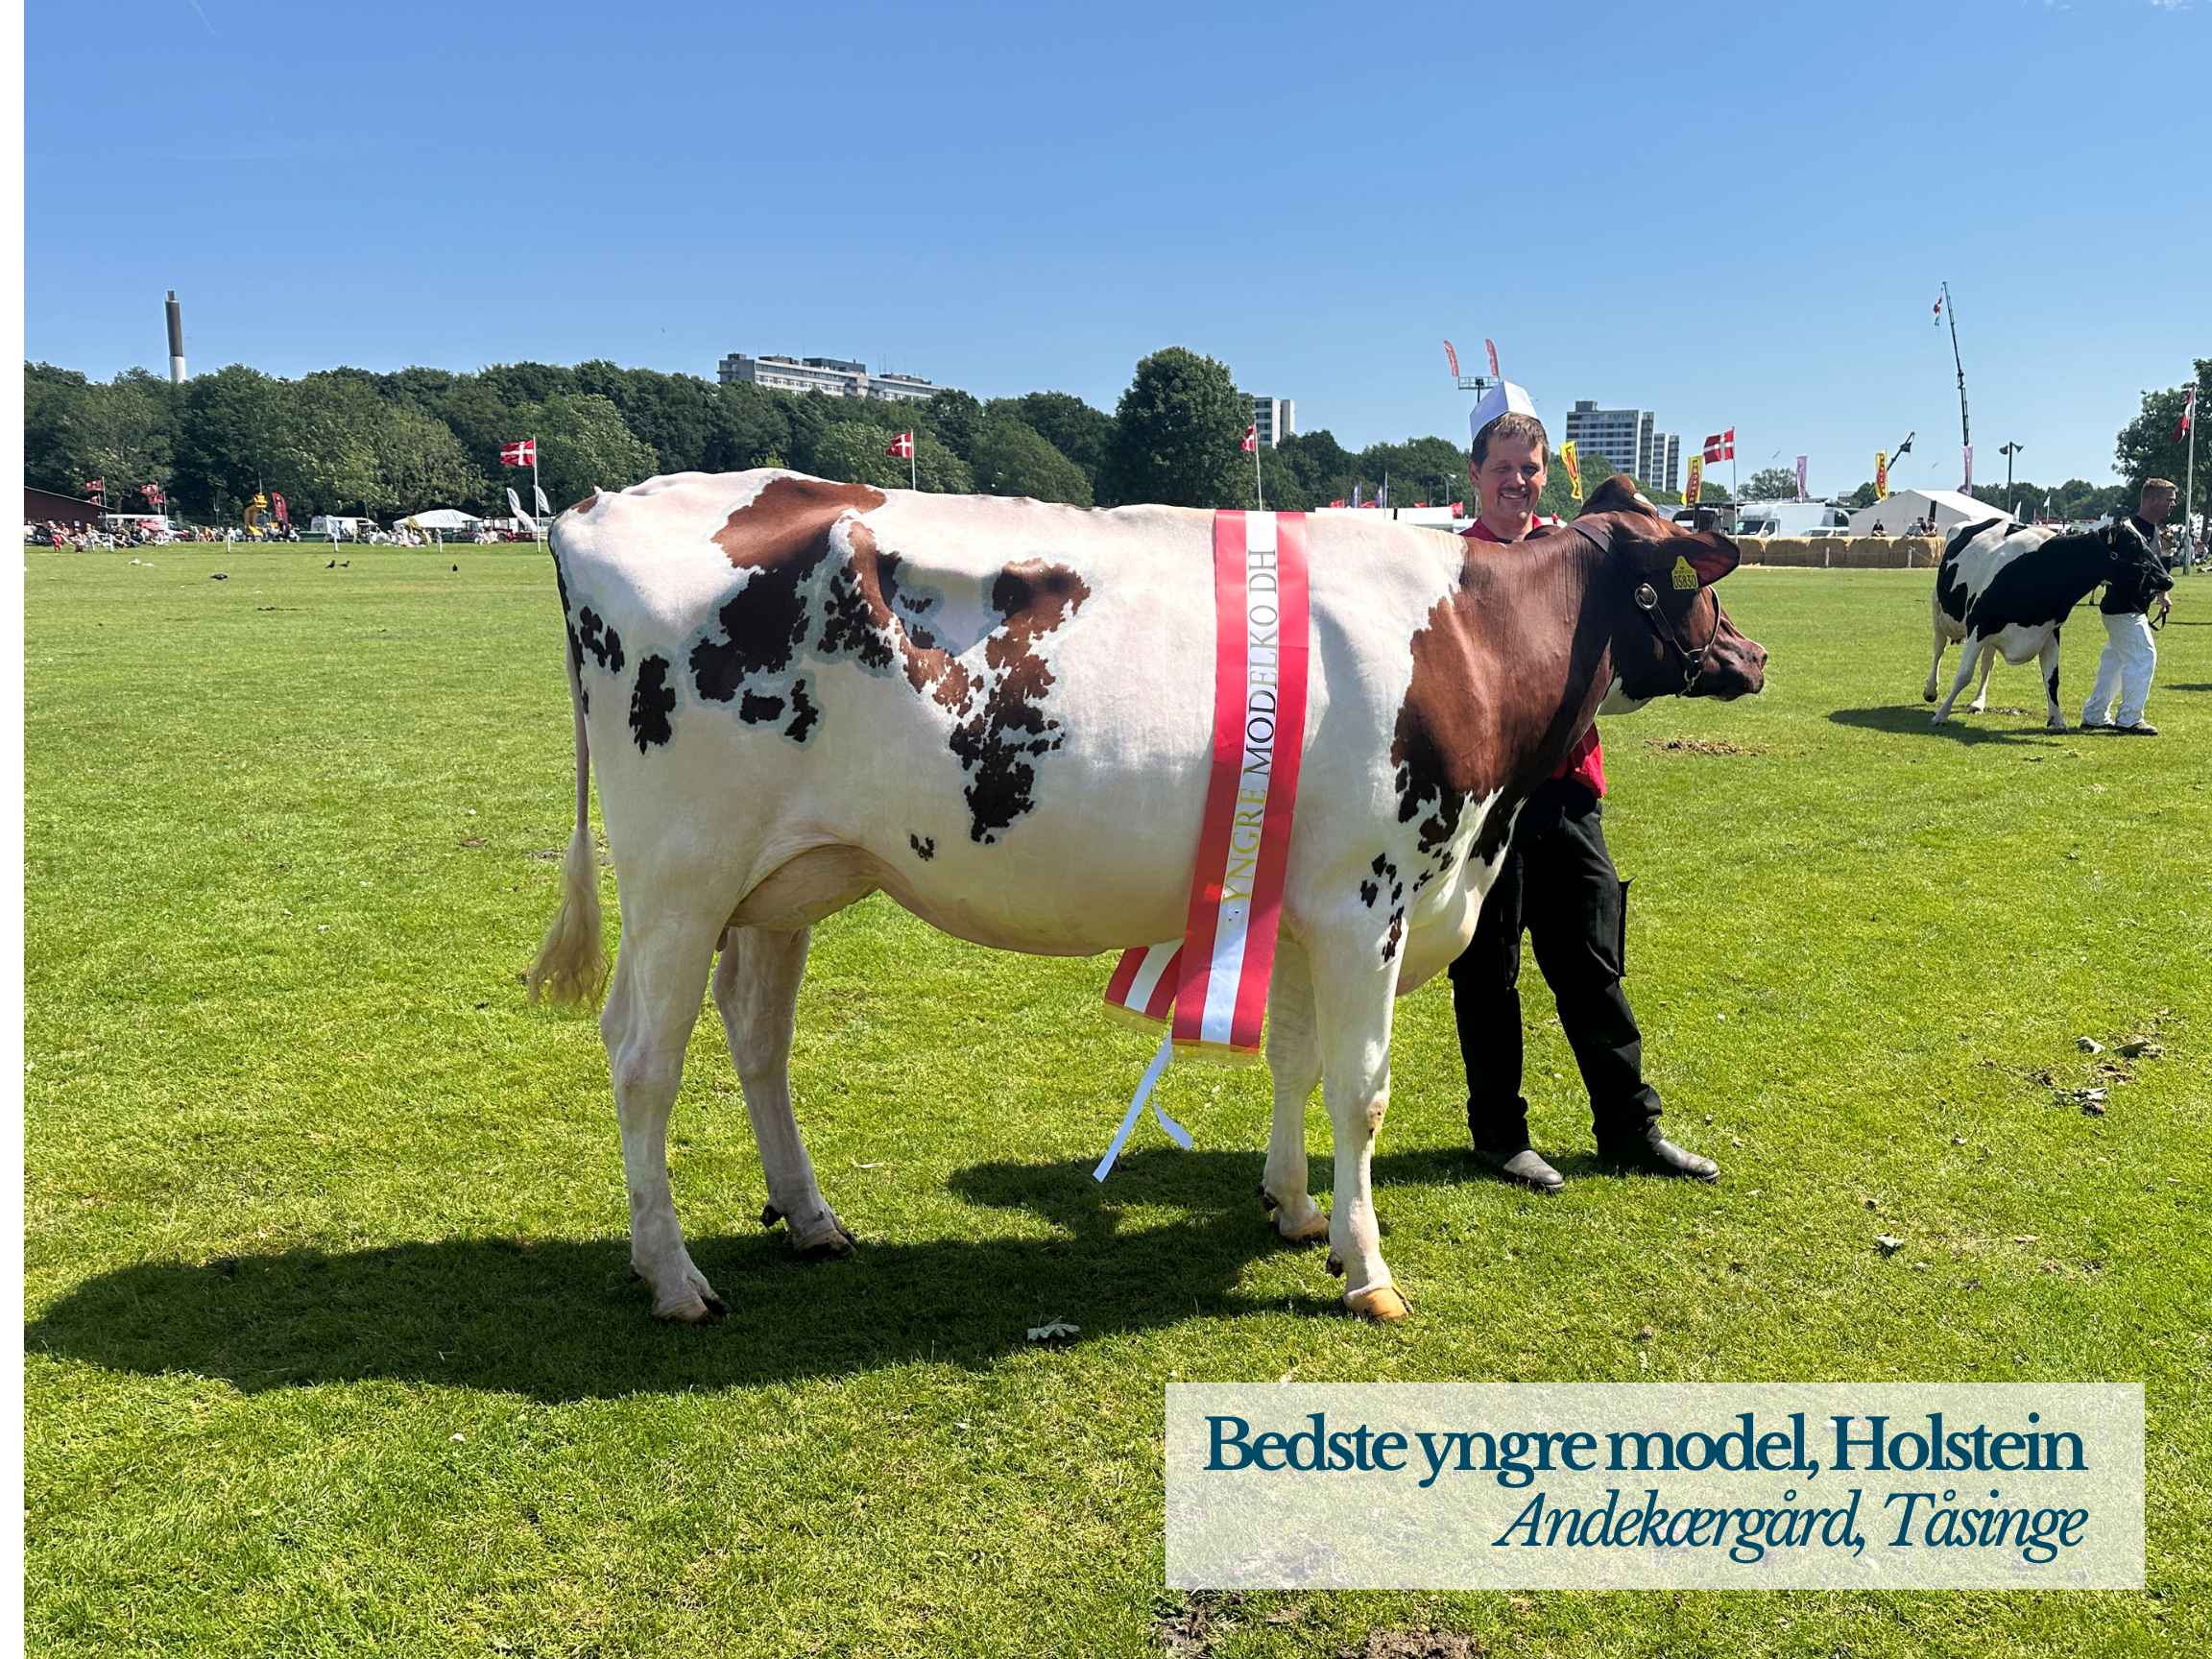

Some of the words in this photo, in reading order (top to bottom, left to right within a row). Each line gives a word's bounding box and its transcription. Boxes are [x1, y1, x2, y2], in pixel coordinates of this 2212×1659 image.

[1248, 549, 1277, 594] DH
[1242, 604, 1278, 779] MODELKO
[1221, 787, 1267, 905] YNGRE
